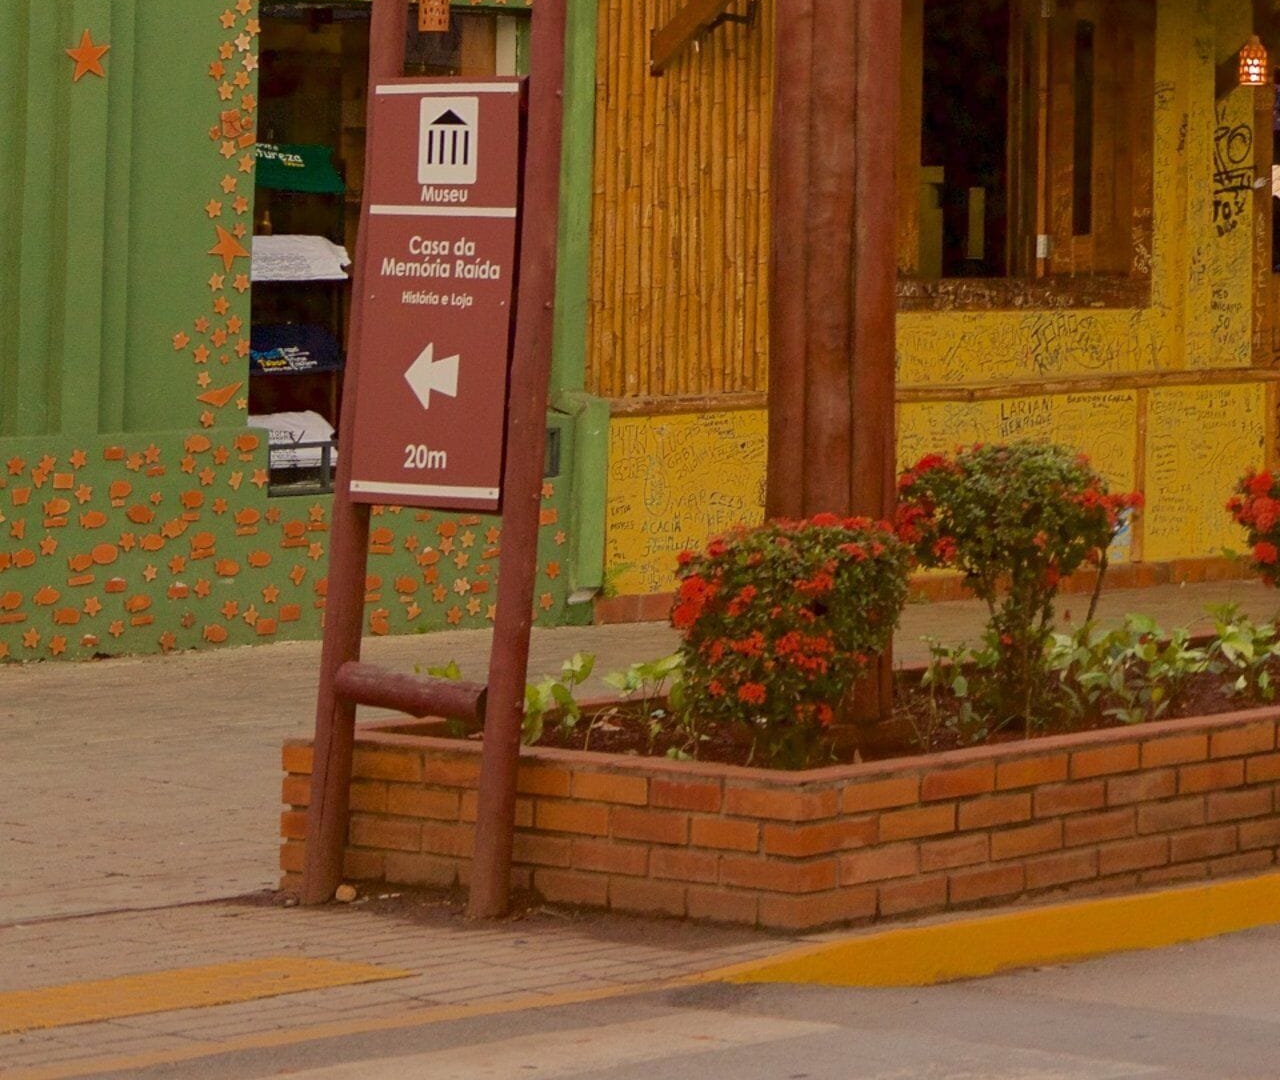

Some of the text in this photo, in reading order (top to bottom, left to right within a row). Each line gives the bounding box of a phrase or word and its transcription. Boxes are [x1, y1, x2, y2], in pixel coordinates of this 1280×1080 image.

[420, 184, 469, 203] Museu
[408, 235, 476, 257] Casa da
[380, 256, 501, 280] Memória Raída
[401, 290, 474, 310] História e Loja
[403, 444, 447, 469] 20m
